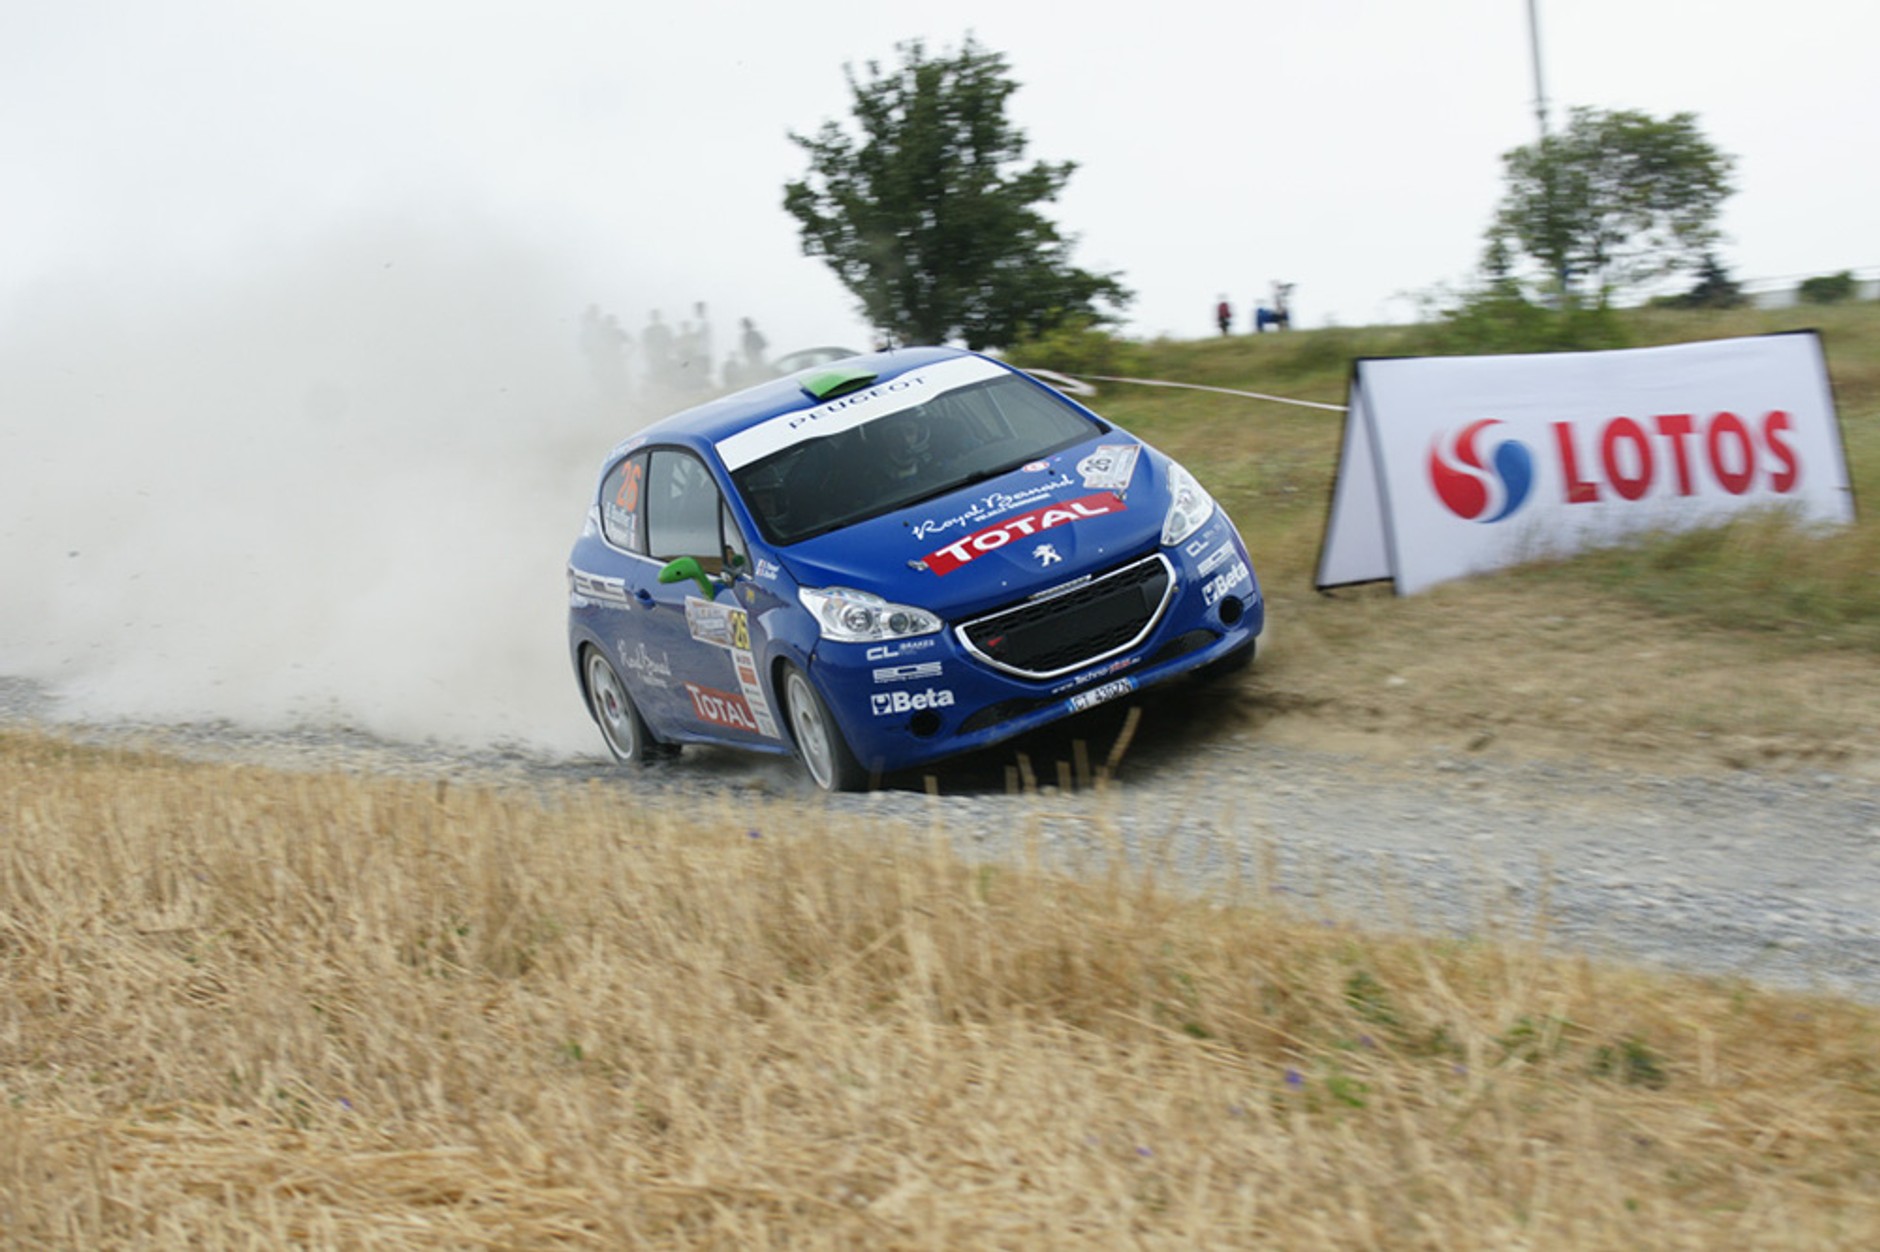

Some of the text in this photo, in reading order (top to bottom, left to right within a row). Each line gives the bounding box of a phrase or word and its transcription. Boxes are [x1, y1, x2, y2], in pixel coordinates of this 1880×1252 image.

[788, 376, 926, 429] PEUGEOT
[1552, 410, 1799, 504] LOTOS
[616, 459, 642, 513] 26
[912, 503, 985, 540] Royal
[935, 501, 1110, 562] TOTAL
[1214, 561, 1249, 597] Beta
[732, 610, 750, 650] 26
[685, 683, 756, 730] TOTAL
[891, 688, 955, 714] Beta
